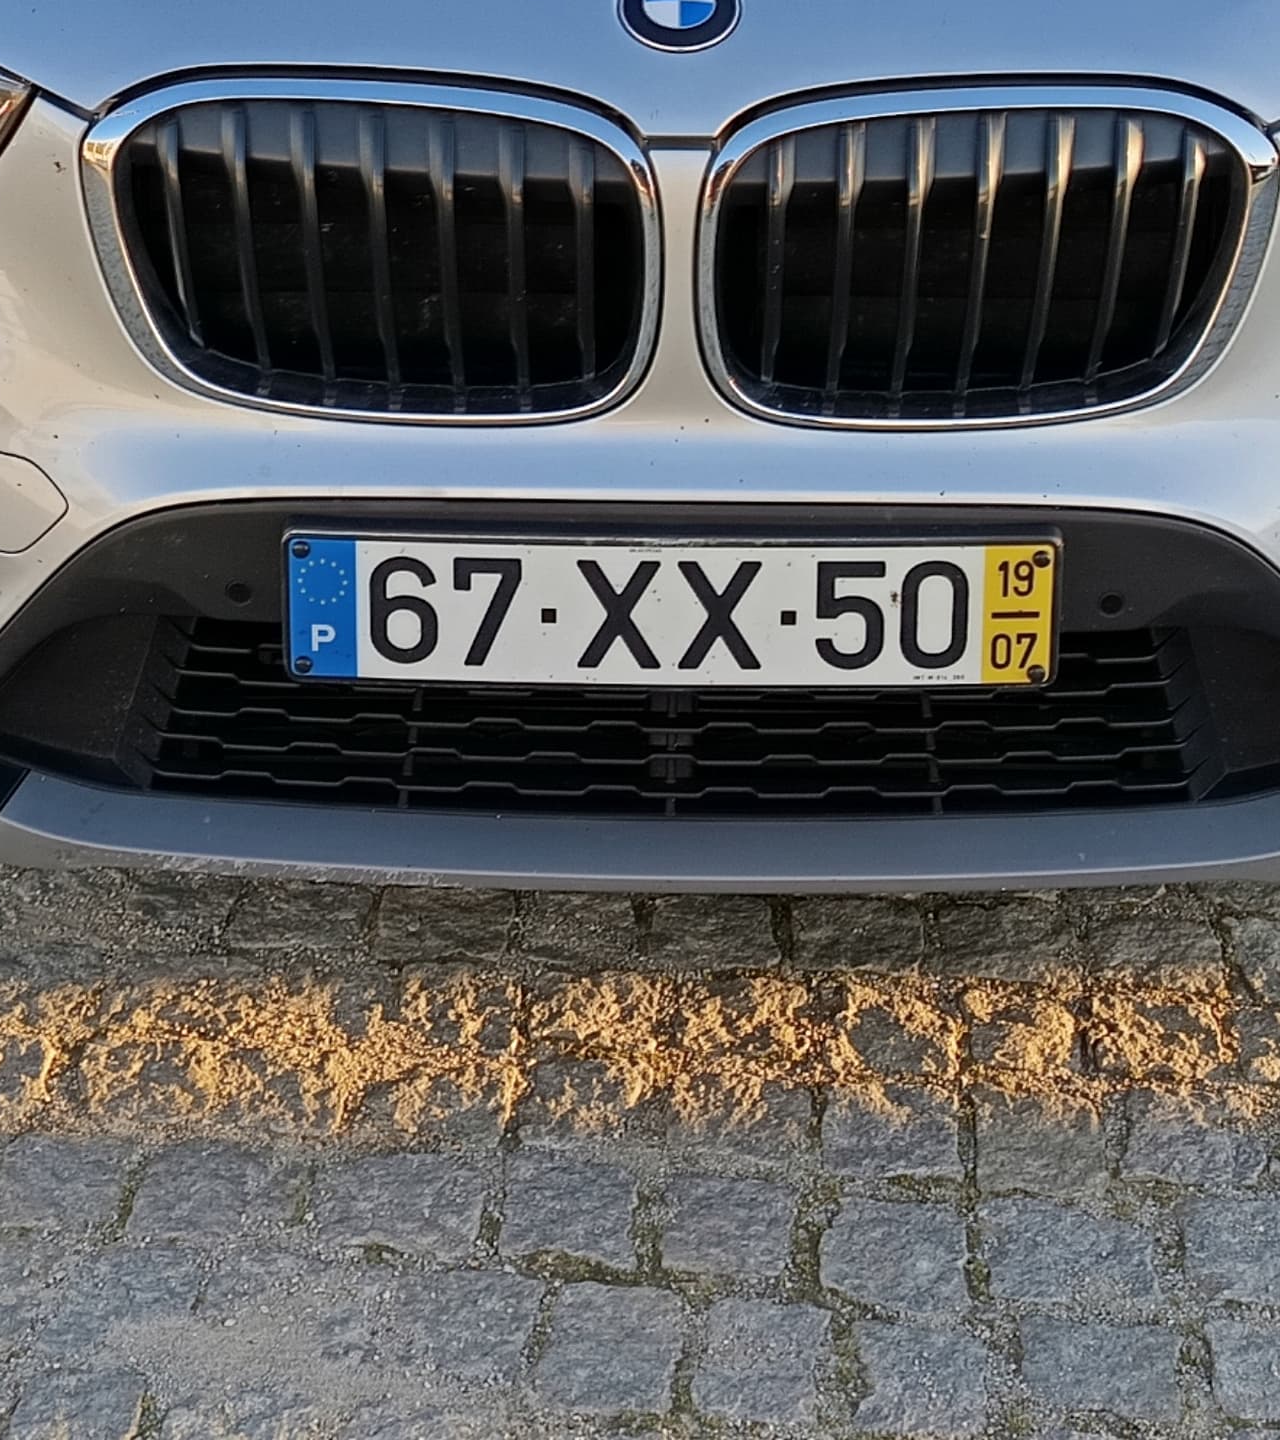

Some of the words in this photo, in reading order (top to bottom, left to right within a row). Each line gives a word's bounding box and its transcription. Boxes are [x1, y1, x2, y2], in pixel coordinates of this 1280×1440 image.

[997, 560, 1035, 598] 19
[311, 623, 337, 653] P
[990, 632, 1038, 670] 07
